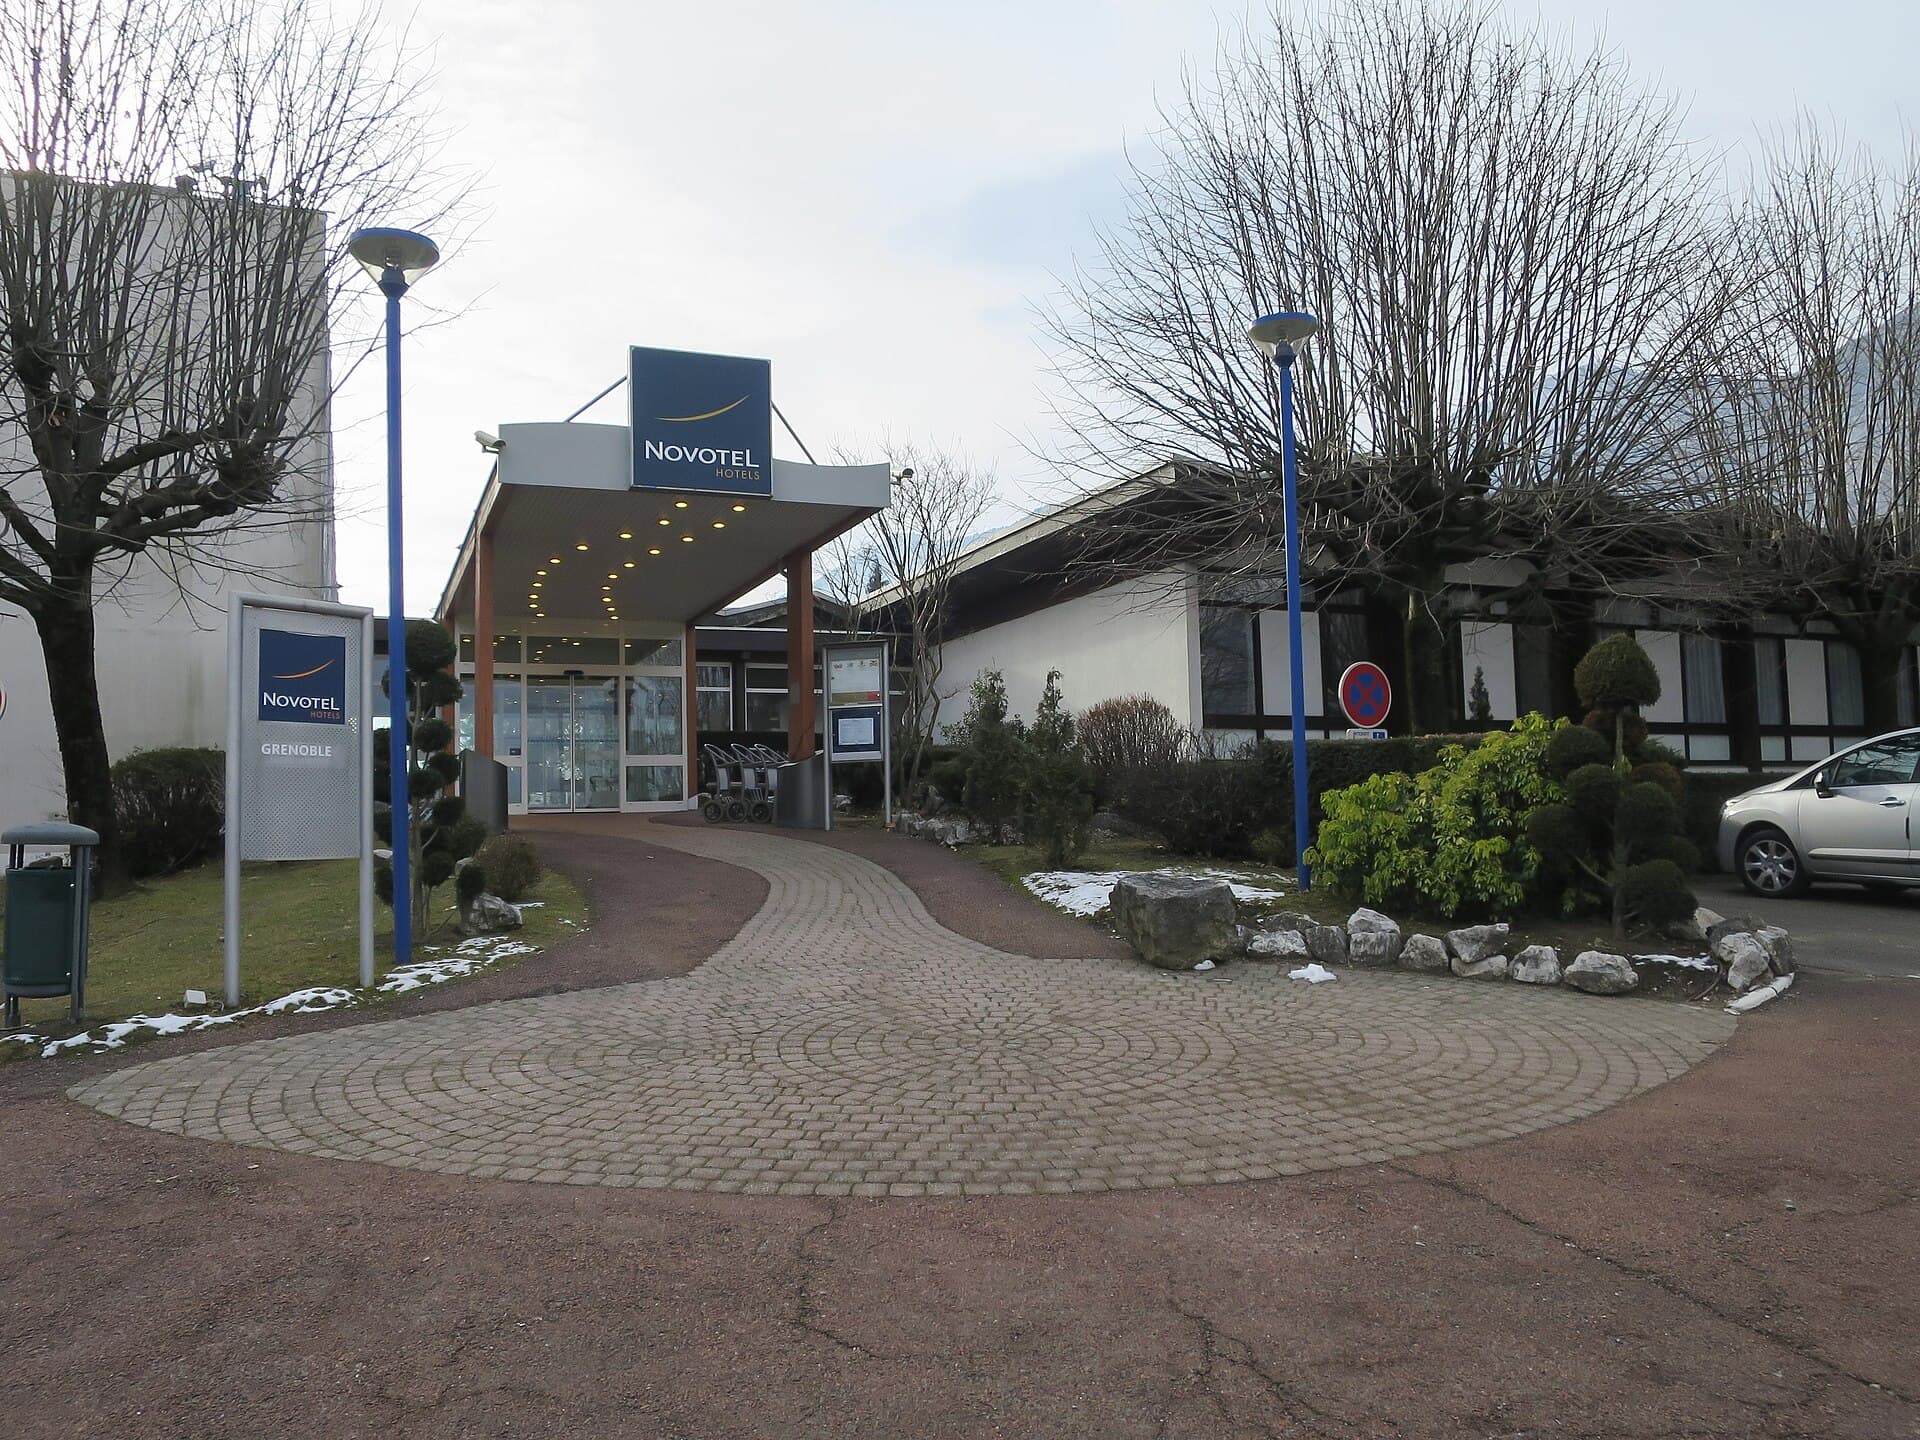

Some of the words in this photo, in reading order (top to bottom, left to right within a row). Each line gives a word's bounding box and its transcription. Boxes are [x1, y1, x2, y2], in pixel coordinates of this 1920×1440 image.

[645, 439, 760, 468] NOVOTEL
[716, 468, 760, 480] HOTELS
[263, 692, 340, 711] NOVOTEL
[310, 711, 341, 720] HOTELS
[261, 743, 332, 757] GRENOBLE
